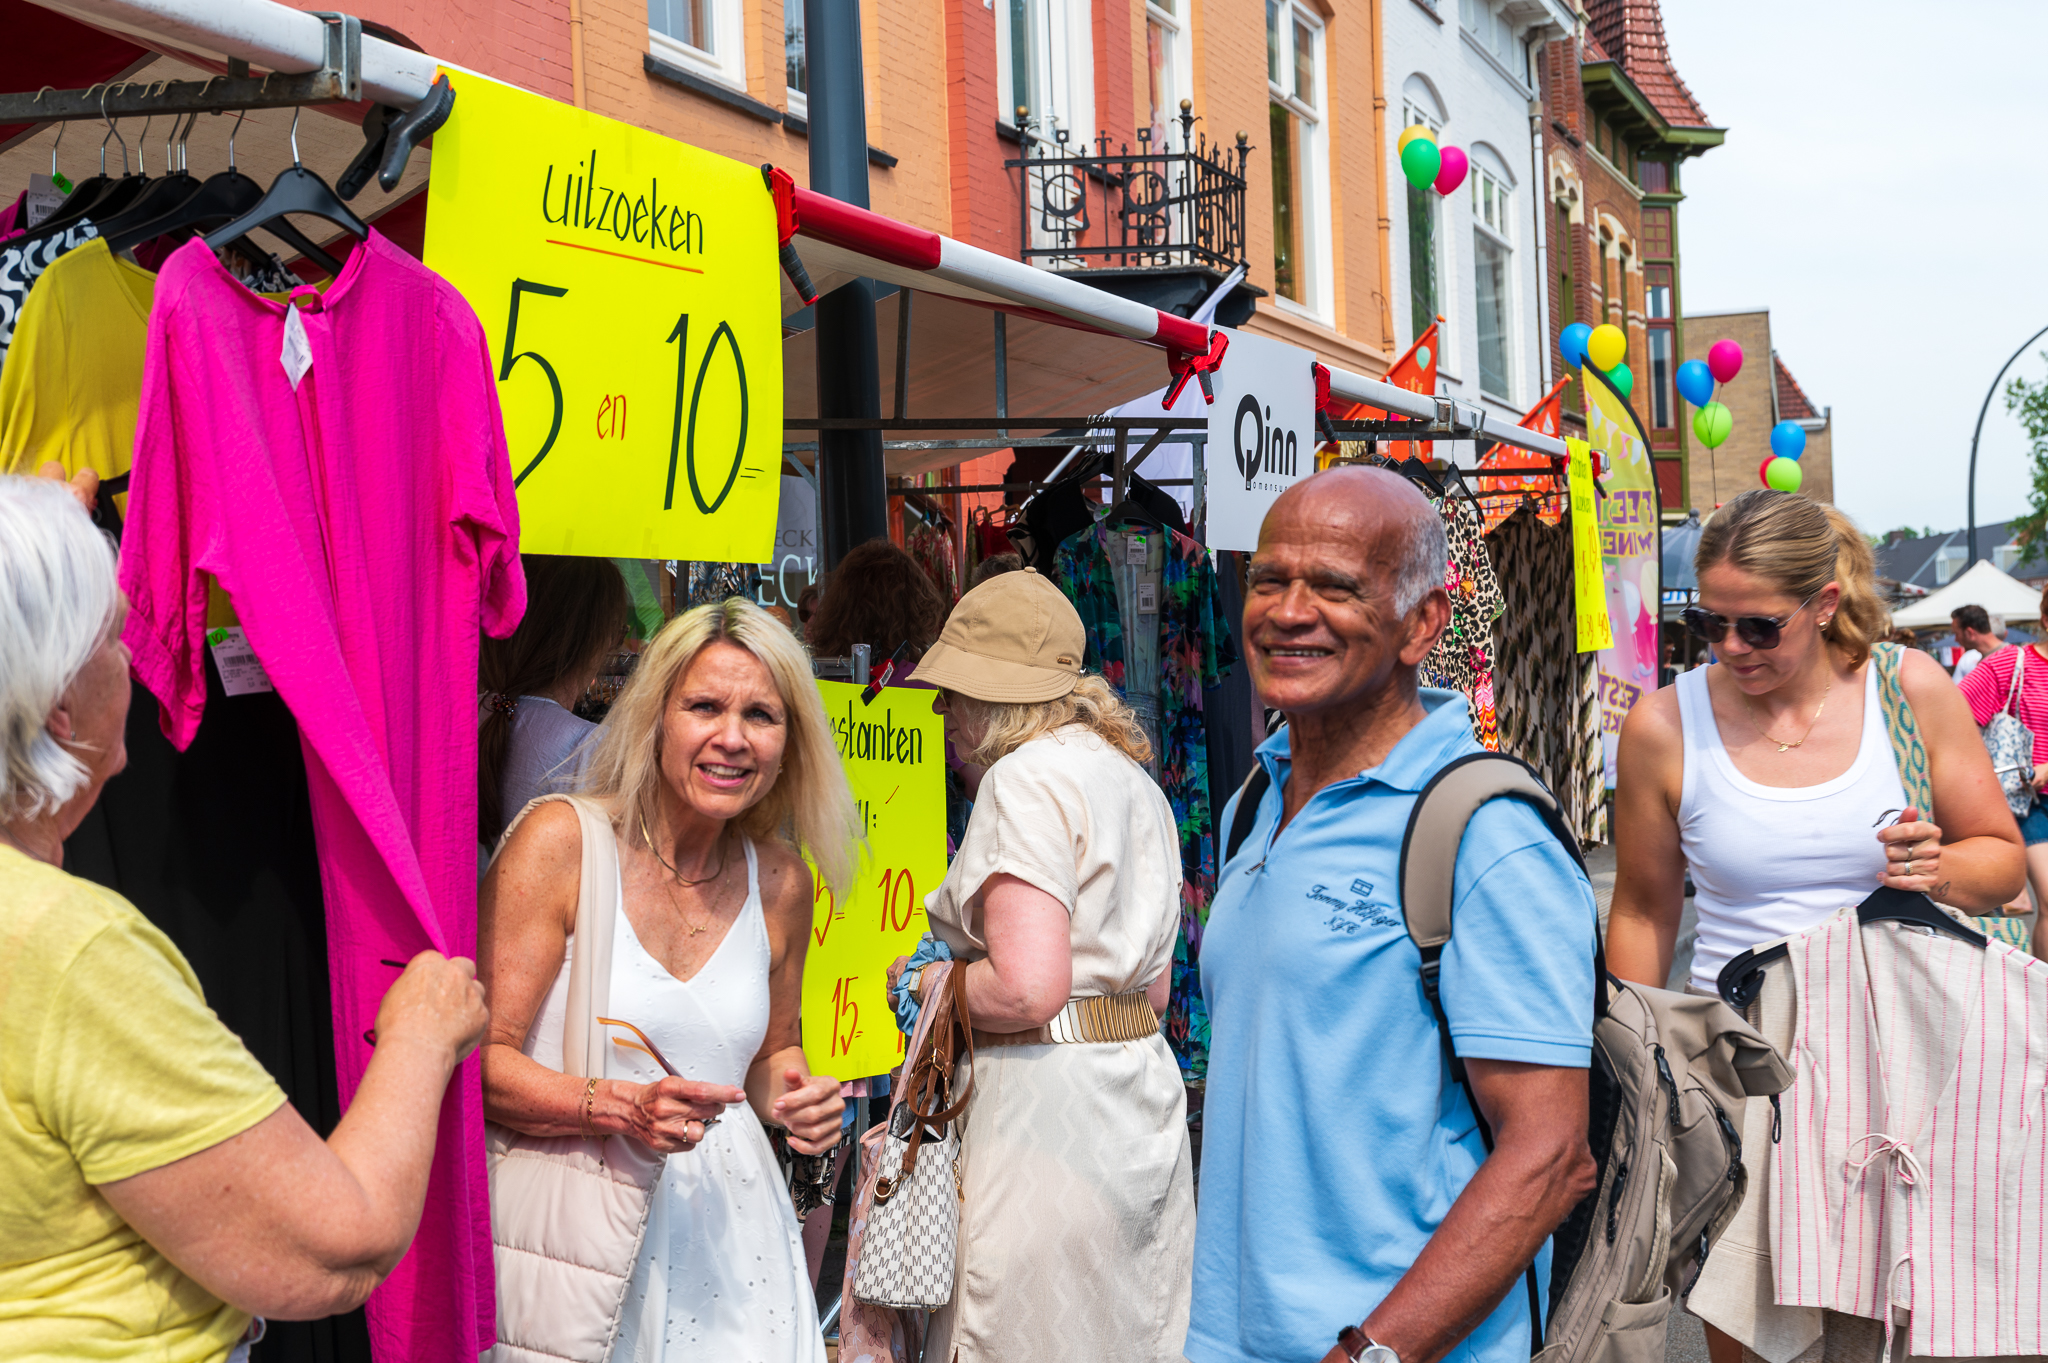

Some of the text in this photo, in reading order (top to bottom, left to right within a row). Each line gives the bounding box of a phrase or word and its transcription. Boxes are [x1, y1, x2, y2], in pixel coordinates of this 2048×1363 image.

[499, 277, 569, 490] 5
[596, 394, 627, 440] en
[1234, 394, 1298, 491] Qinn
[826, 699, 923, 765] estanten
